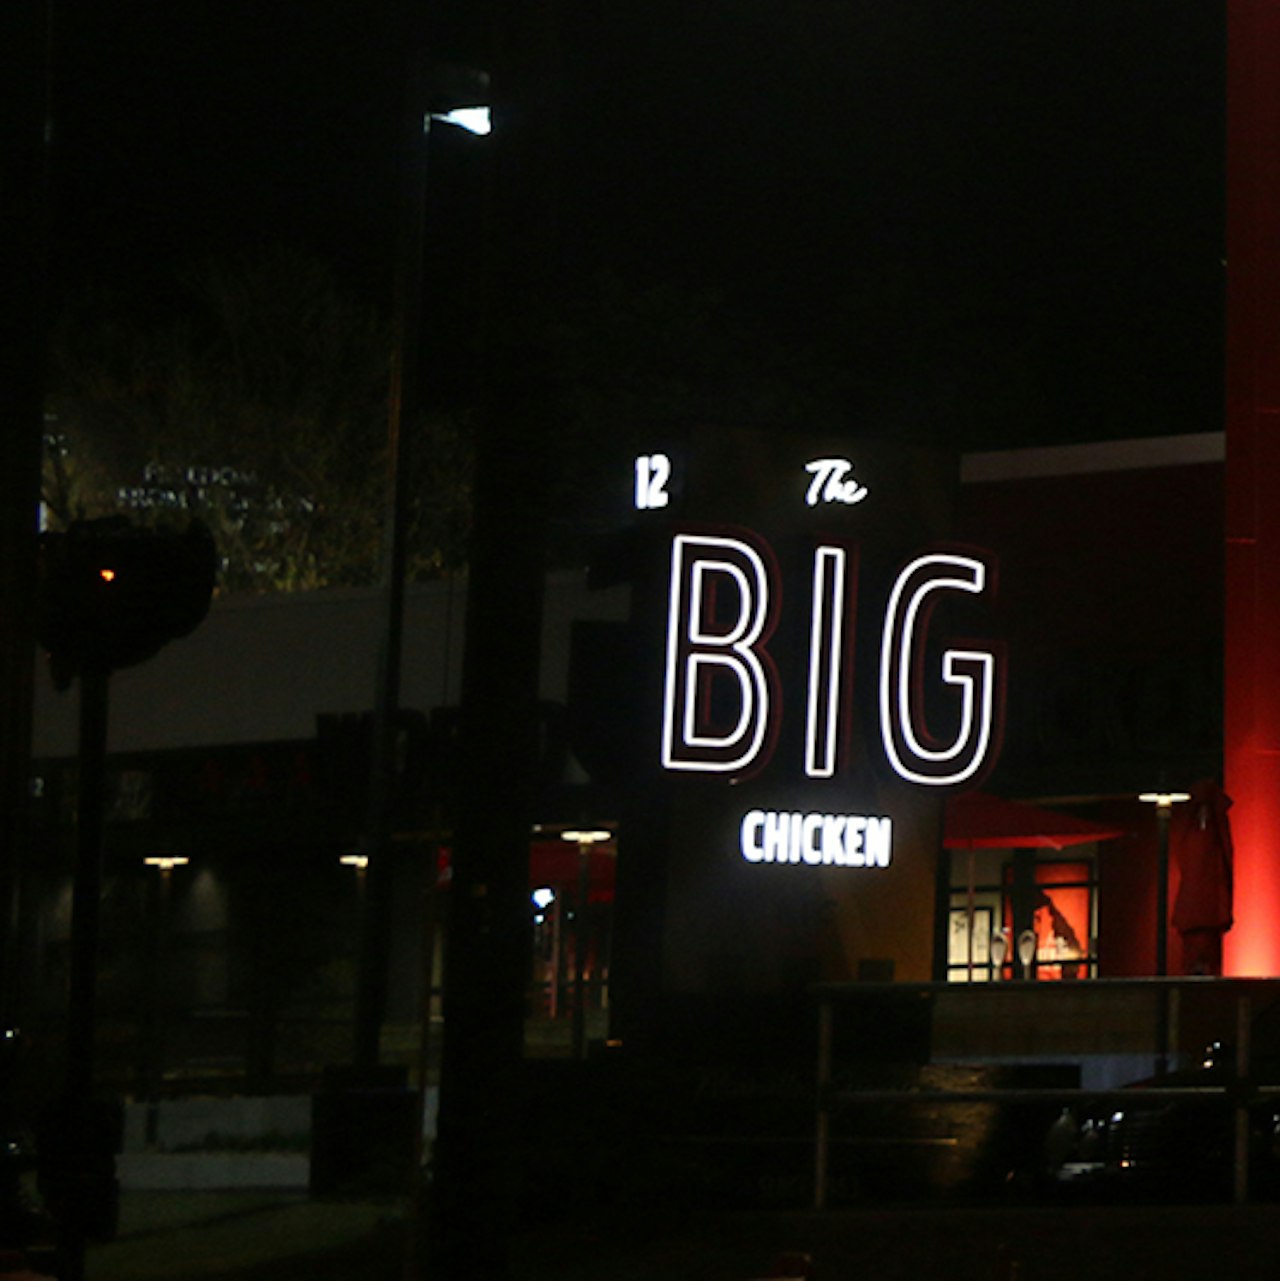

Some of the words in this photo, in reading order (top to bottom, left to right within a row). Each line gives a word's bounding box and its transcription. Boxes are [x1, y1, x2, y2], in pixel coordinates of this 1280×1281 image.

[634, 454, 671, 510] 12
[805, 458, 868, 506] The
[661, 534, 993, 785] BIG
[740, 809, 892, 868] CHICKEN
